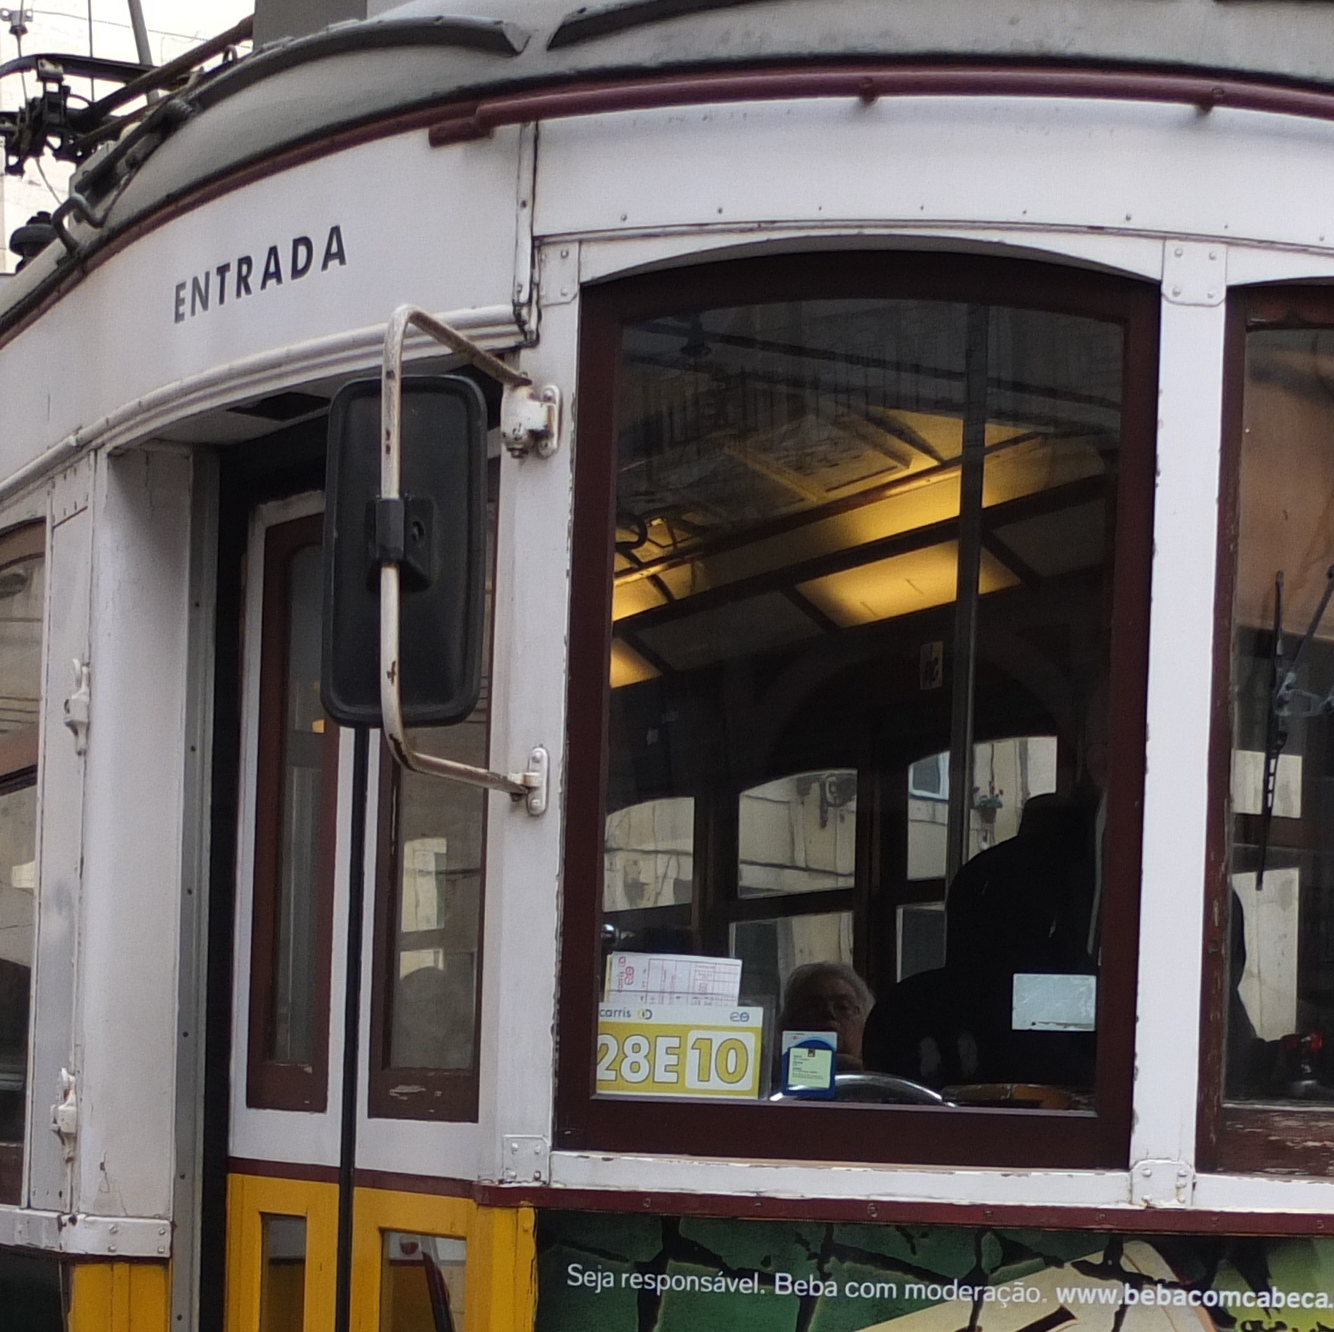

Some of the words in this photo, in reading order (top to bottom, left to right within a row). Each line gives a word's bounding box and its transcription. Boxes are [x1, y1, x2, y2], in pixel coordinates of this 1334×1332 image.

[174, 224, 347, 324] ENTRADA
[599, 1007, 632, 1019] carris
[597, 1032, 682, 1083] 28E
[690, 1037, 749, 1085] 10
[567, 1263, 614, 1293] Seja
[621, 1270, 766, 1296] responsável.
[774, 1272, 838, 1298] Beba
[845, 1280, 897, 1300] com
[904, 1279, 1048, 1309] moderação.
